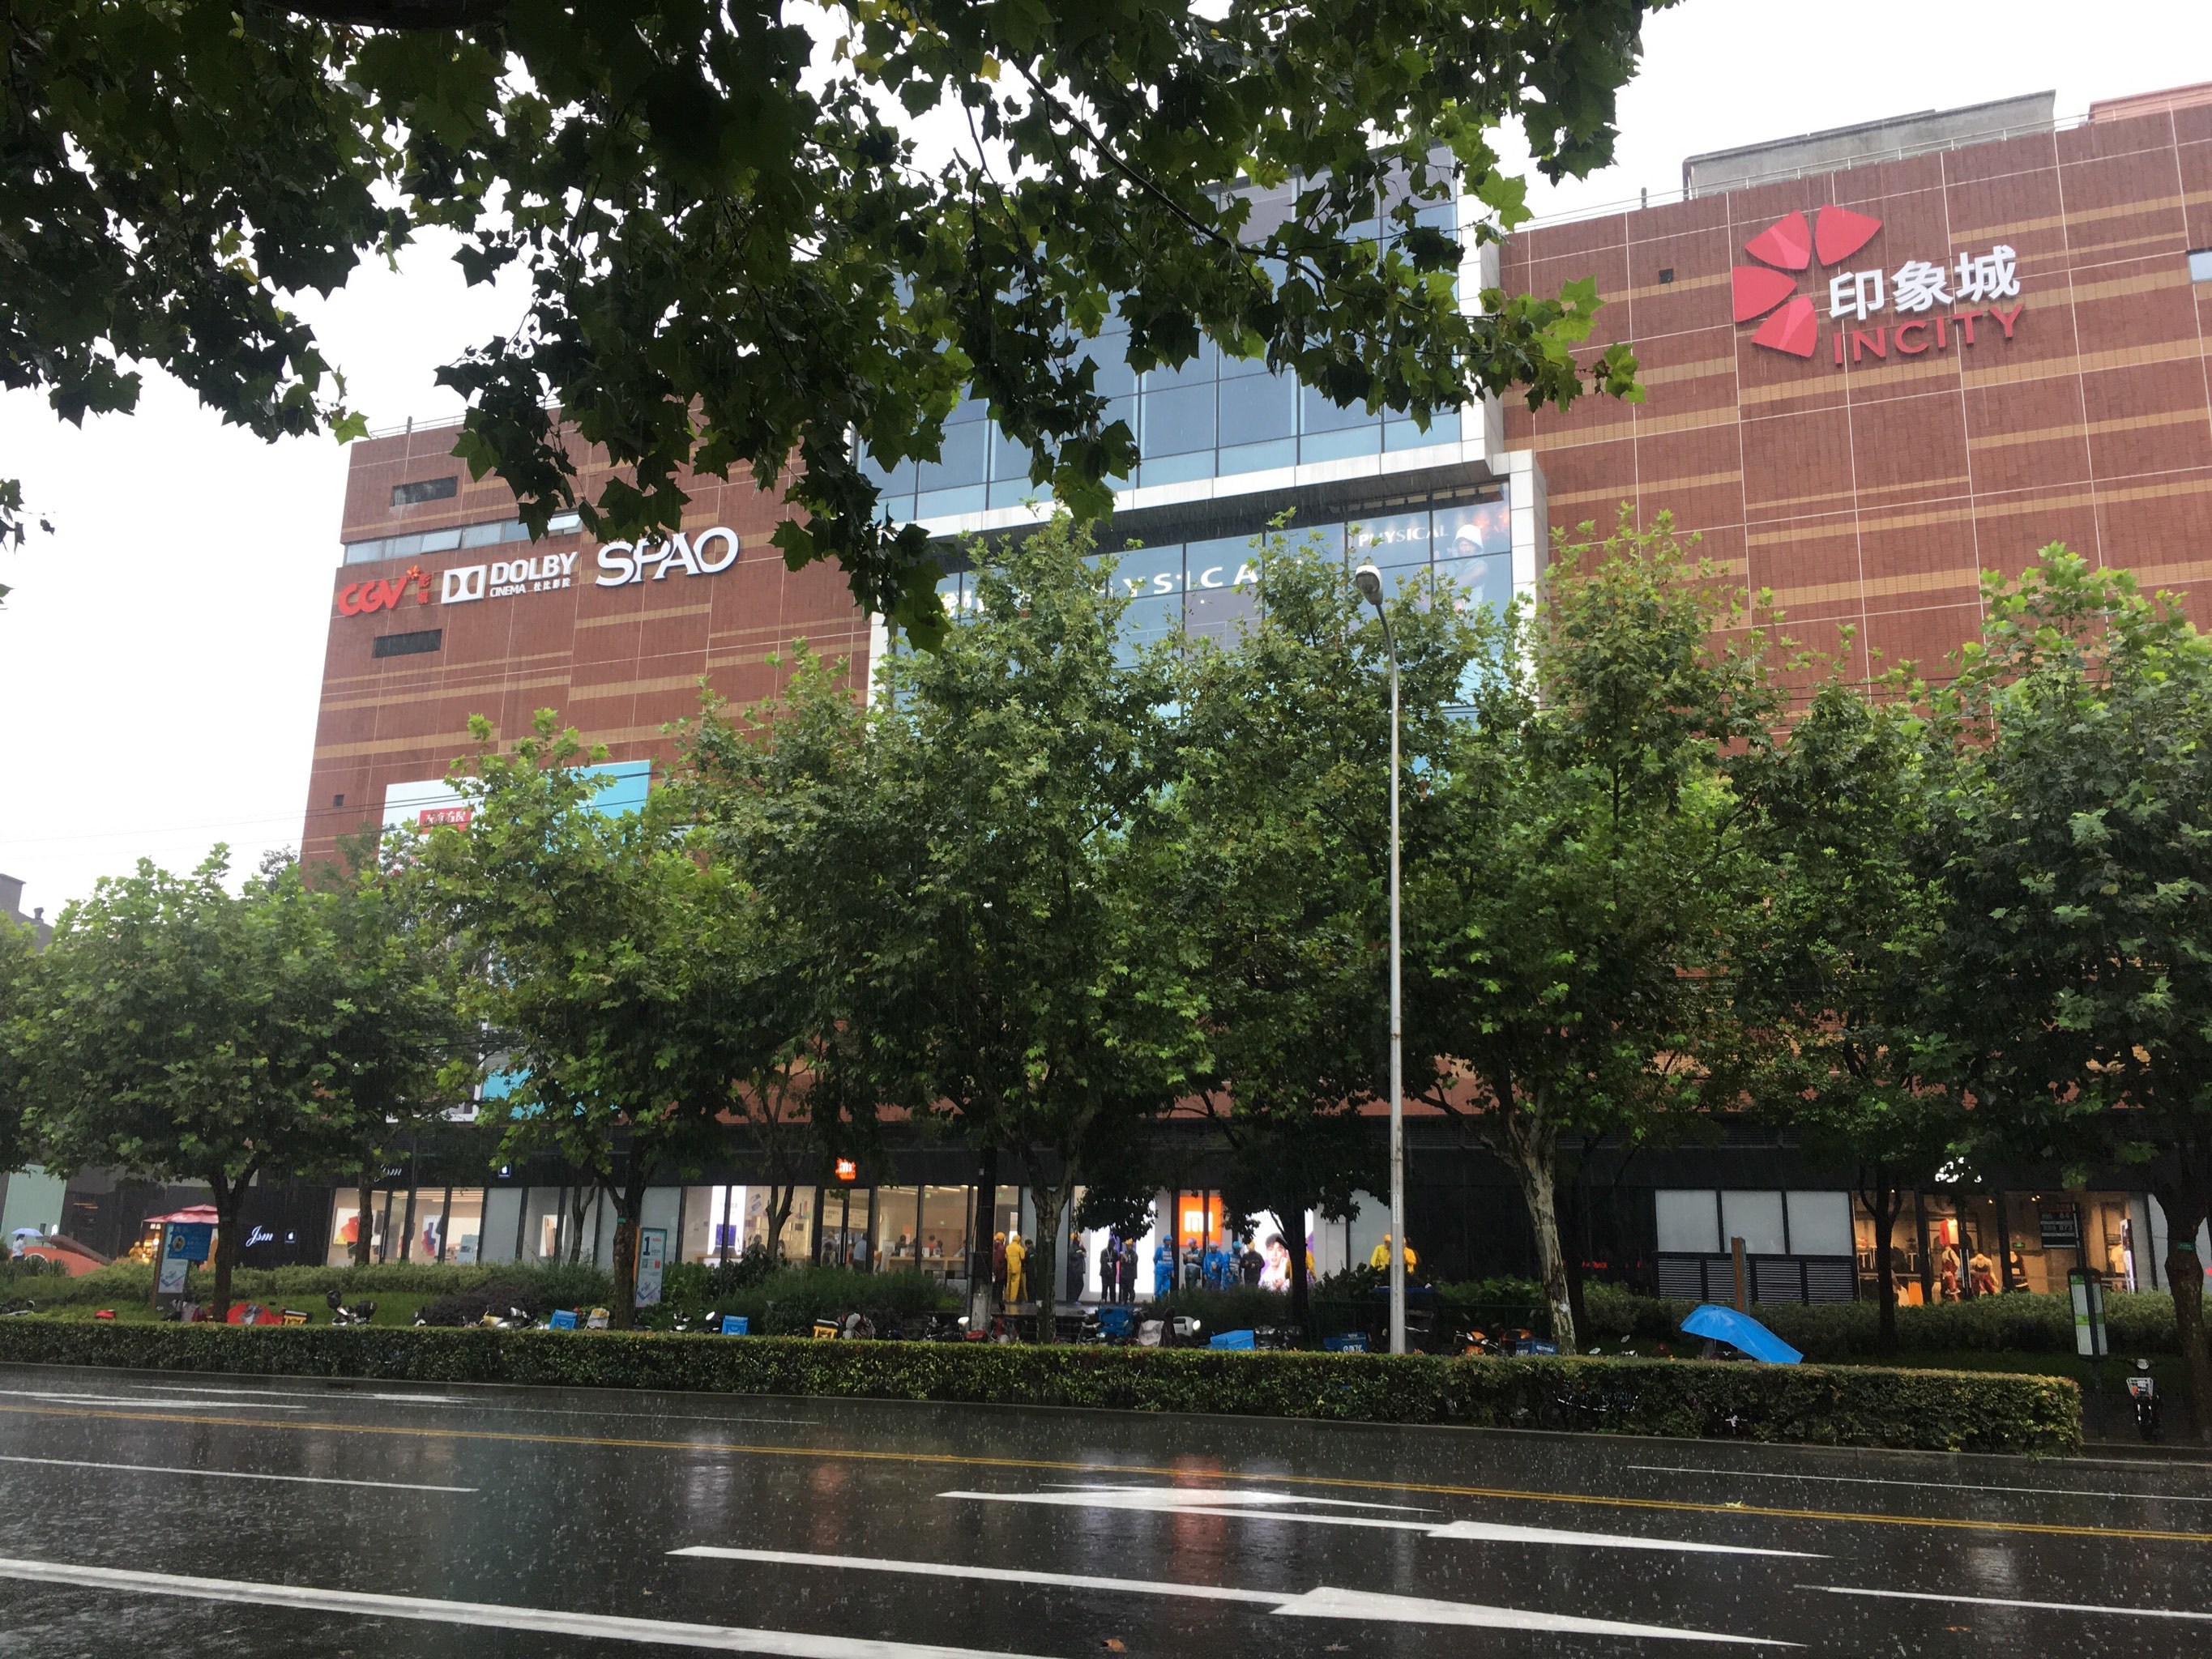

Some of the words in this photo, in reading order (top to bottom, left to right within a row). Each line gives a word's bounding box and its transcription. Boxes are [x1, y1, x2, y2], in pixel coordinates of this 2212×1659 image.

[1829, 245, 2020, 321] 印象城
[1834, 304, 2024, 365] INCITY
[489, 552, 579, 585] DOLBY
[596, 527, 740, 586] SPAO
[338, 576, 408, 616] CGV
[489, 584, 526, 597] CINEMA
[246, 1225, 273, 1247] Jsm
